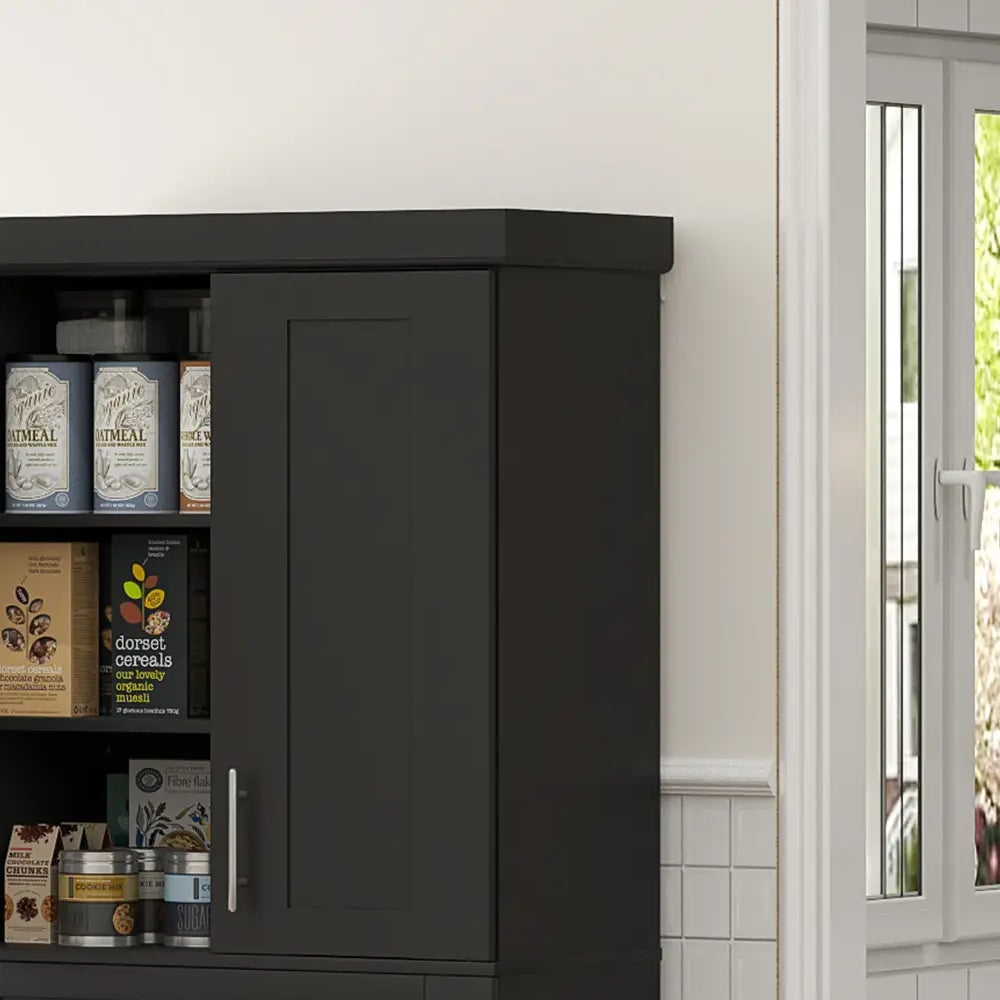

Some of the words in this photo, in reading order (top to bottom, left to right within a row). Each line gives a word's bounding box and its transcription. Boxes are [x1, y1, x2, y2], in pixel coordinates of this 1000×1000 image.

[115, 635, 167, 651] dorset
[115, 652, 173, 668] cereals
[33, 674, 64, 684] granola
[115, 671, 134, 680] our
[135, 669, 166, 682] lovely
[115, 681, 154, 693] organic
[115, 693, 151, 703] muesli
[6, 866, 49, 875] CHUNKS
[75, 883, 107, 891] COOKIE
